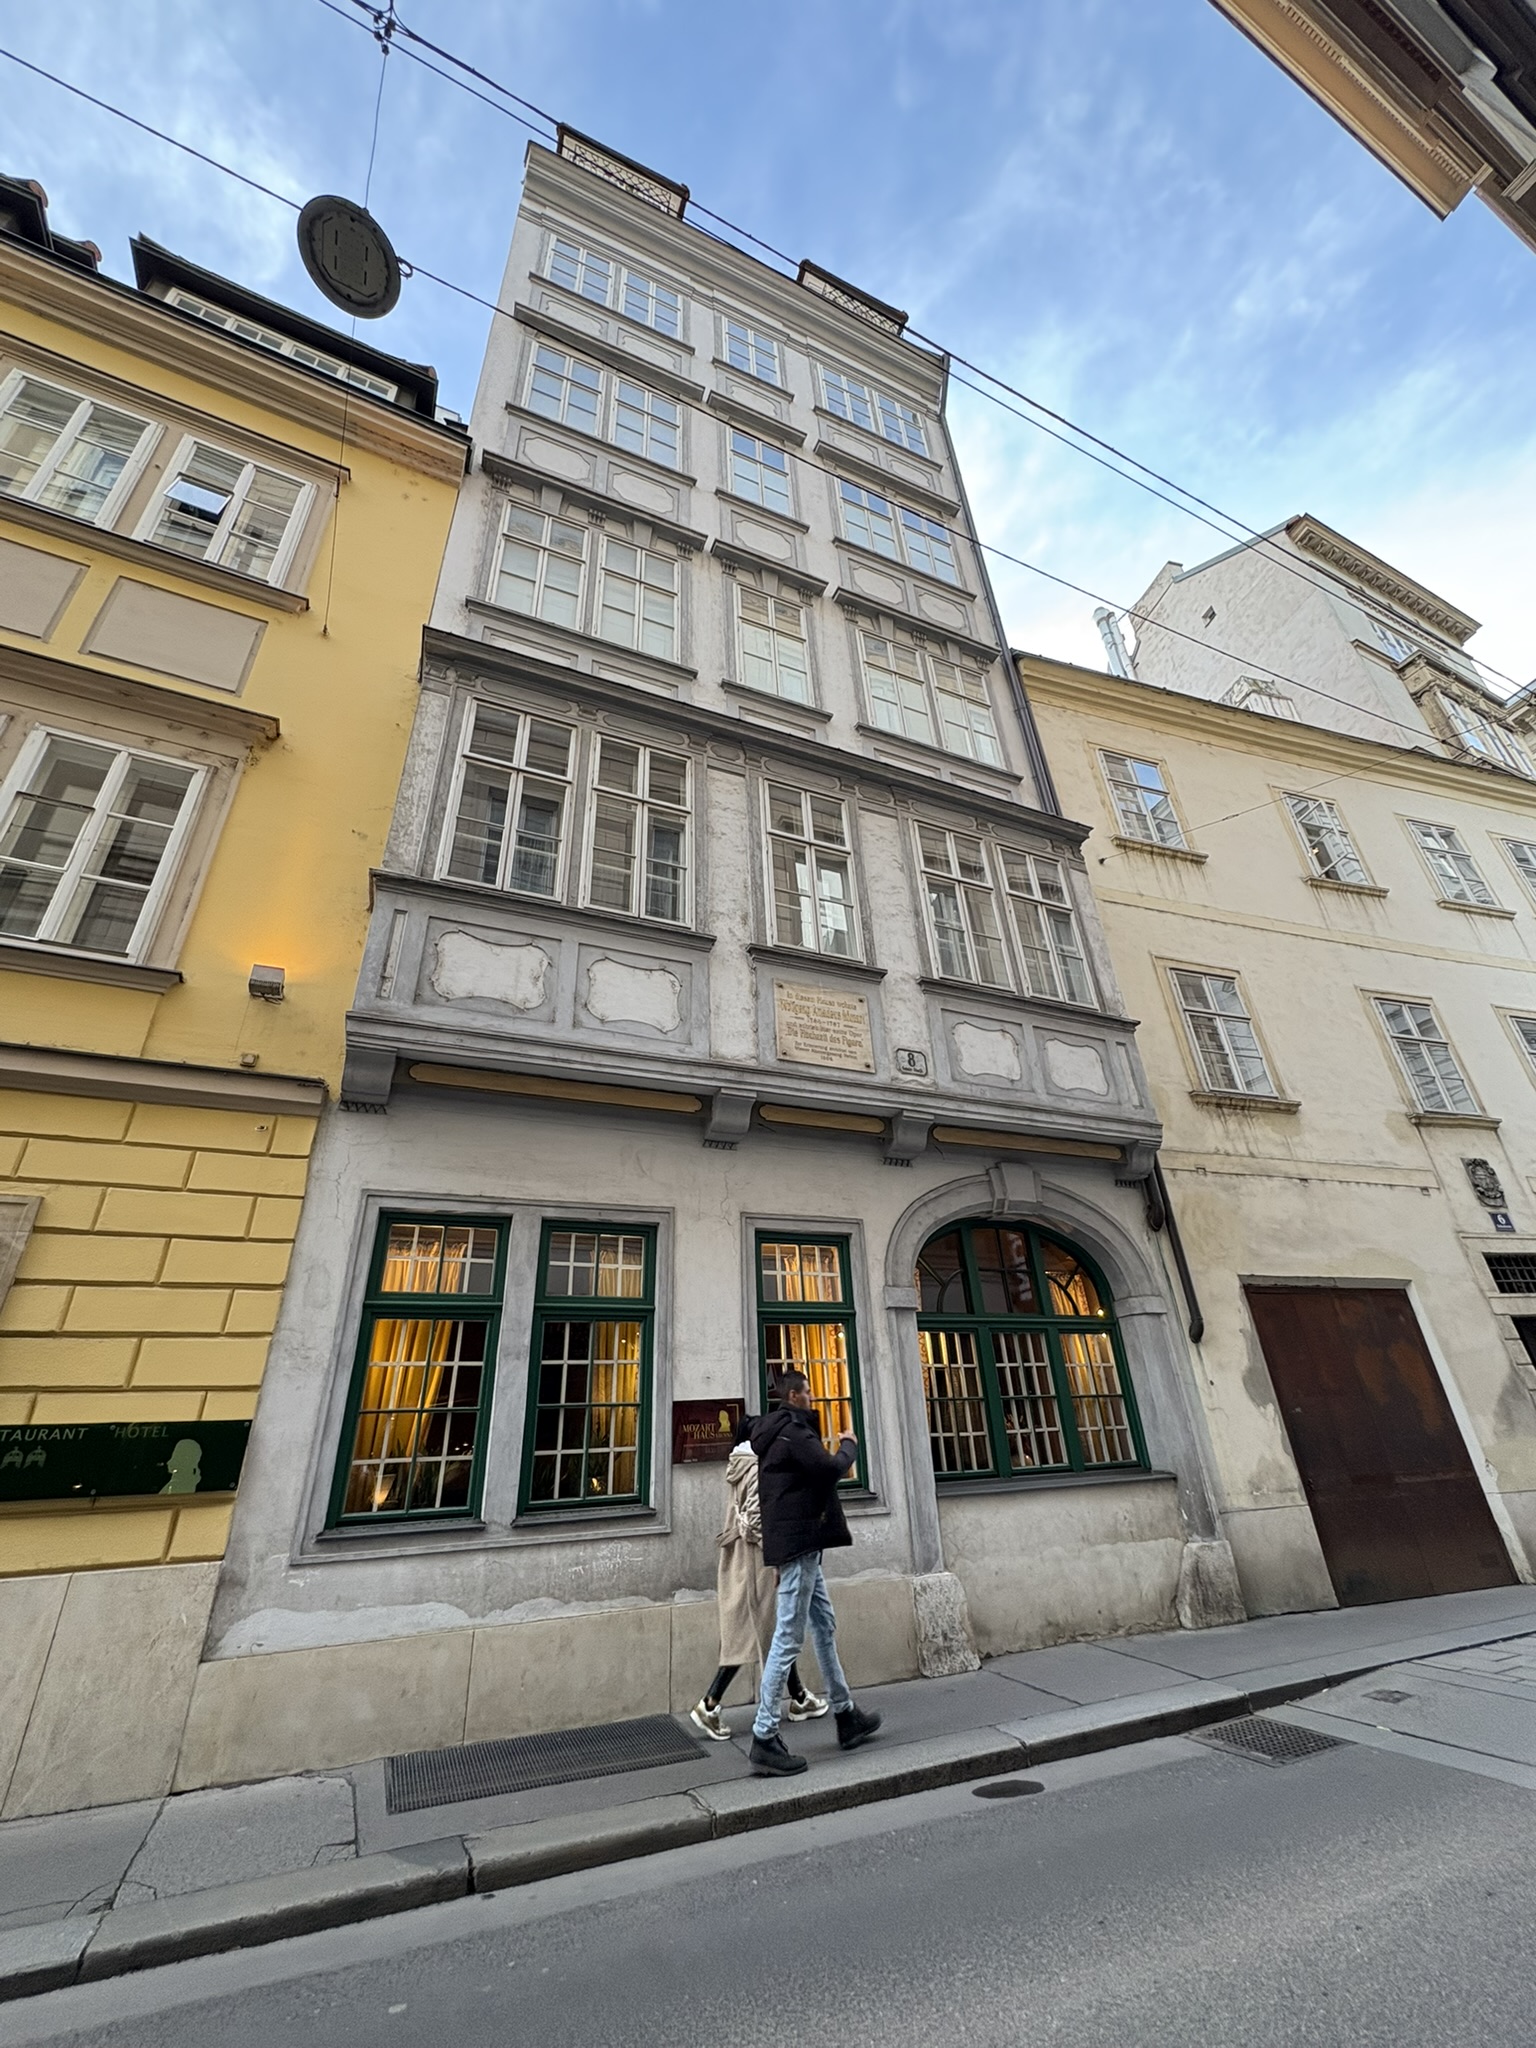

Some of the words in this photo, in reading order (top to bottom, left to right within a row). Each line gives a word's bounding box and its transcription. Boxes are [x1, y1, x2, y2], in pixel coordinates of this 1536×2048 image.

[907, 1052, 916, 1067] 8
[1496, 1214, 1506, 1225] 6
[682, 1423, 715, 1433] MOZART
[693, 1431, 715, 1440] HAUS
